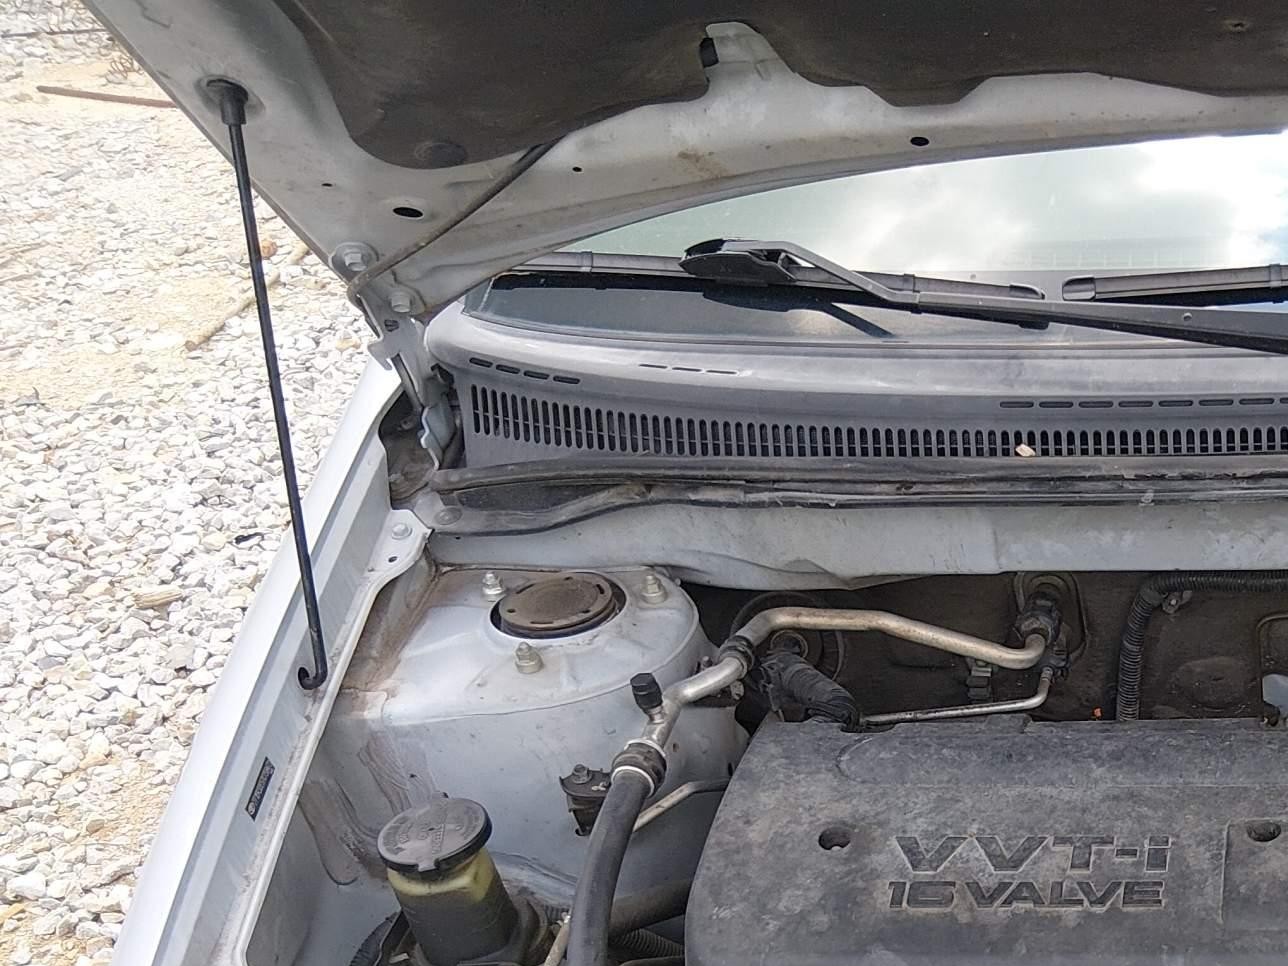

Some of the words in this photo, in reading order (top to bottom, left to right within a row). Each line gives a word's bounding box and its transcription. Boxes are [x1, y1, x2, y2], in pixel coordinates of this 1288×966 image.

[894, 835, 1172, 874] VVT-i
[887, 880, 956, 909] 16
[965, 880, 1165, 910] VALVE
